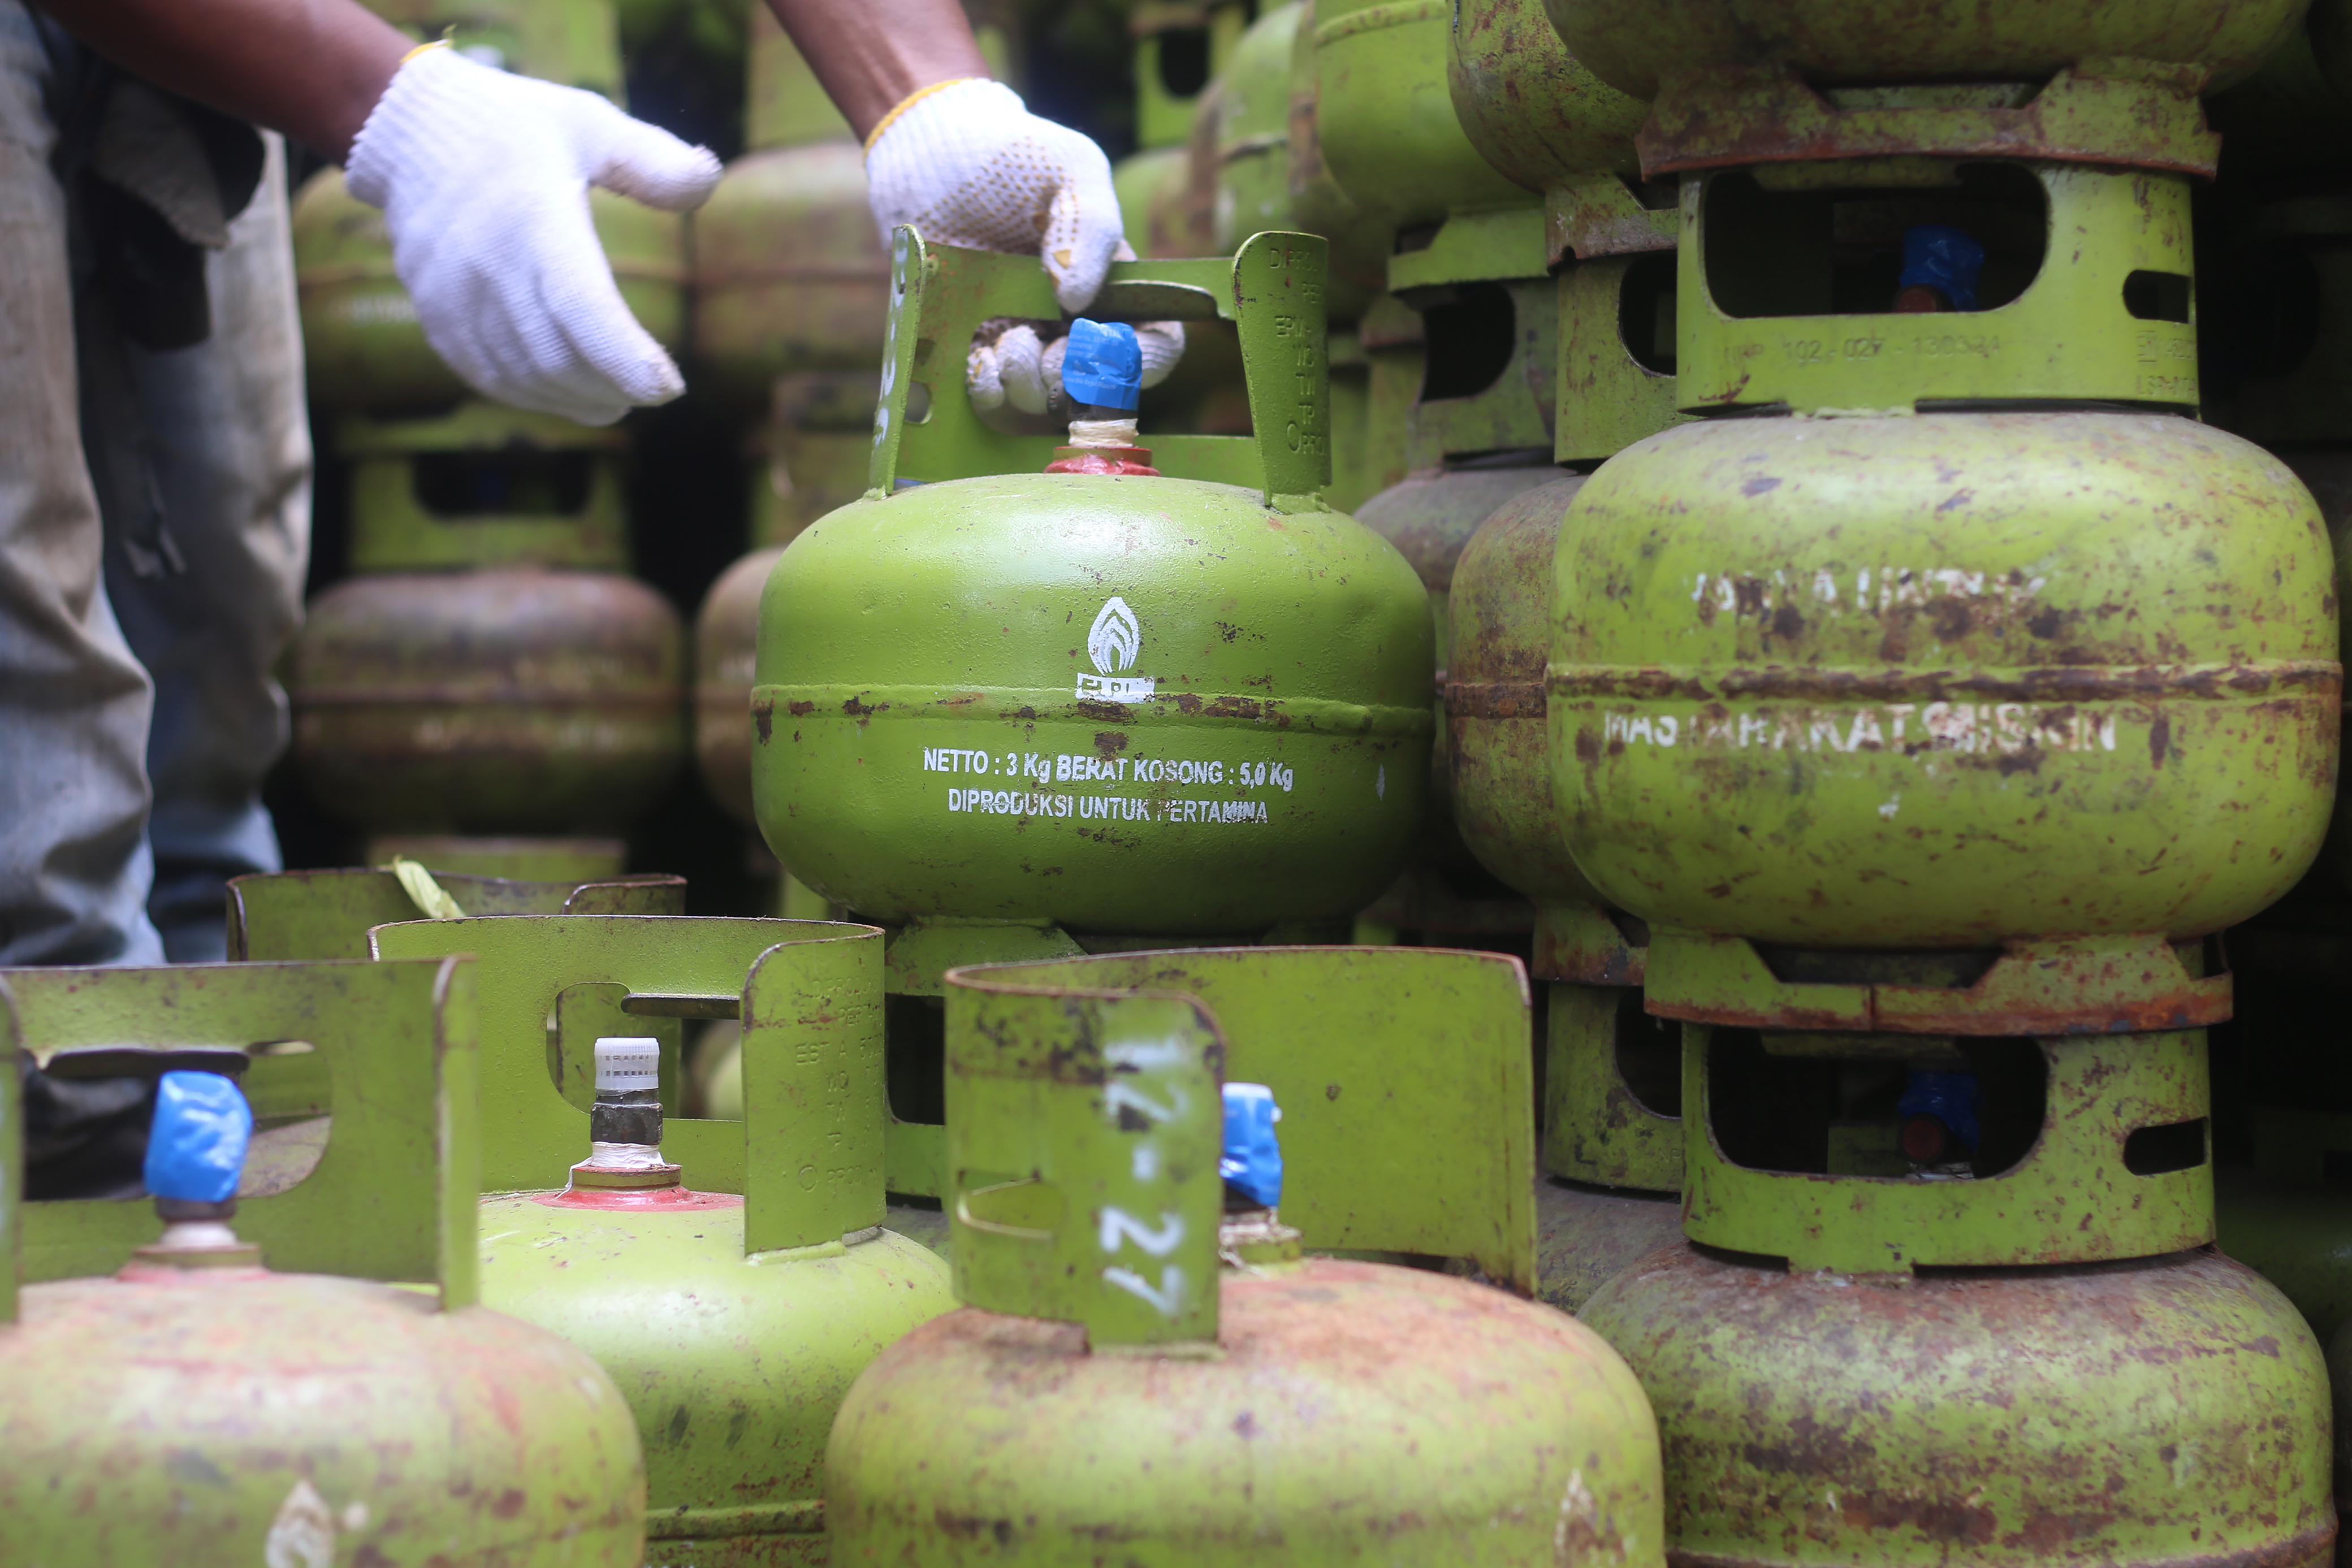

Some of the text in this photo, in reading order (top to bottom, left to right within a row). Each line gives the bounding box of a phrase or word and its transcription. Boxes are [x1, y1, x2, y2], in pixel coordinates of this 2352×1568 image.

[1604, 704, 1917, 753] MASARAKAT
[923, 747, 989, 774] NETTO
[1006, 752, 1018, 776] 3
[1024, 752, 1051, 784] Kg
[1056, 754, 1129, 782] BERAT
[1134, 759, 1223, 785] KOSONG
[1240, 761, 1266, 790] 5,0
[1270, 761, 1294, 791] Kg
[948, 789, 1268, 824] DIPRODUKSI UNTUK PERTAMINA
